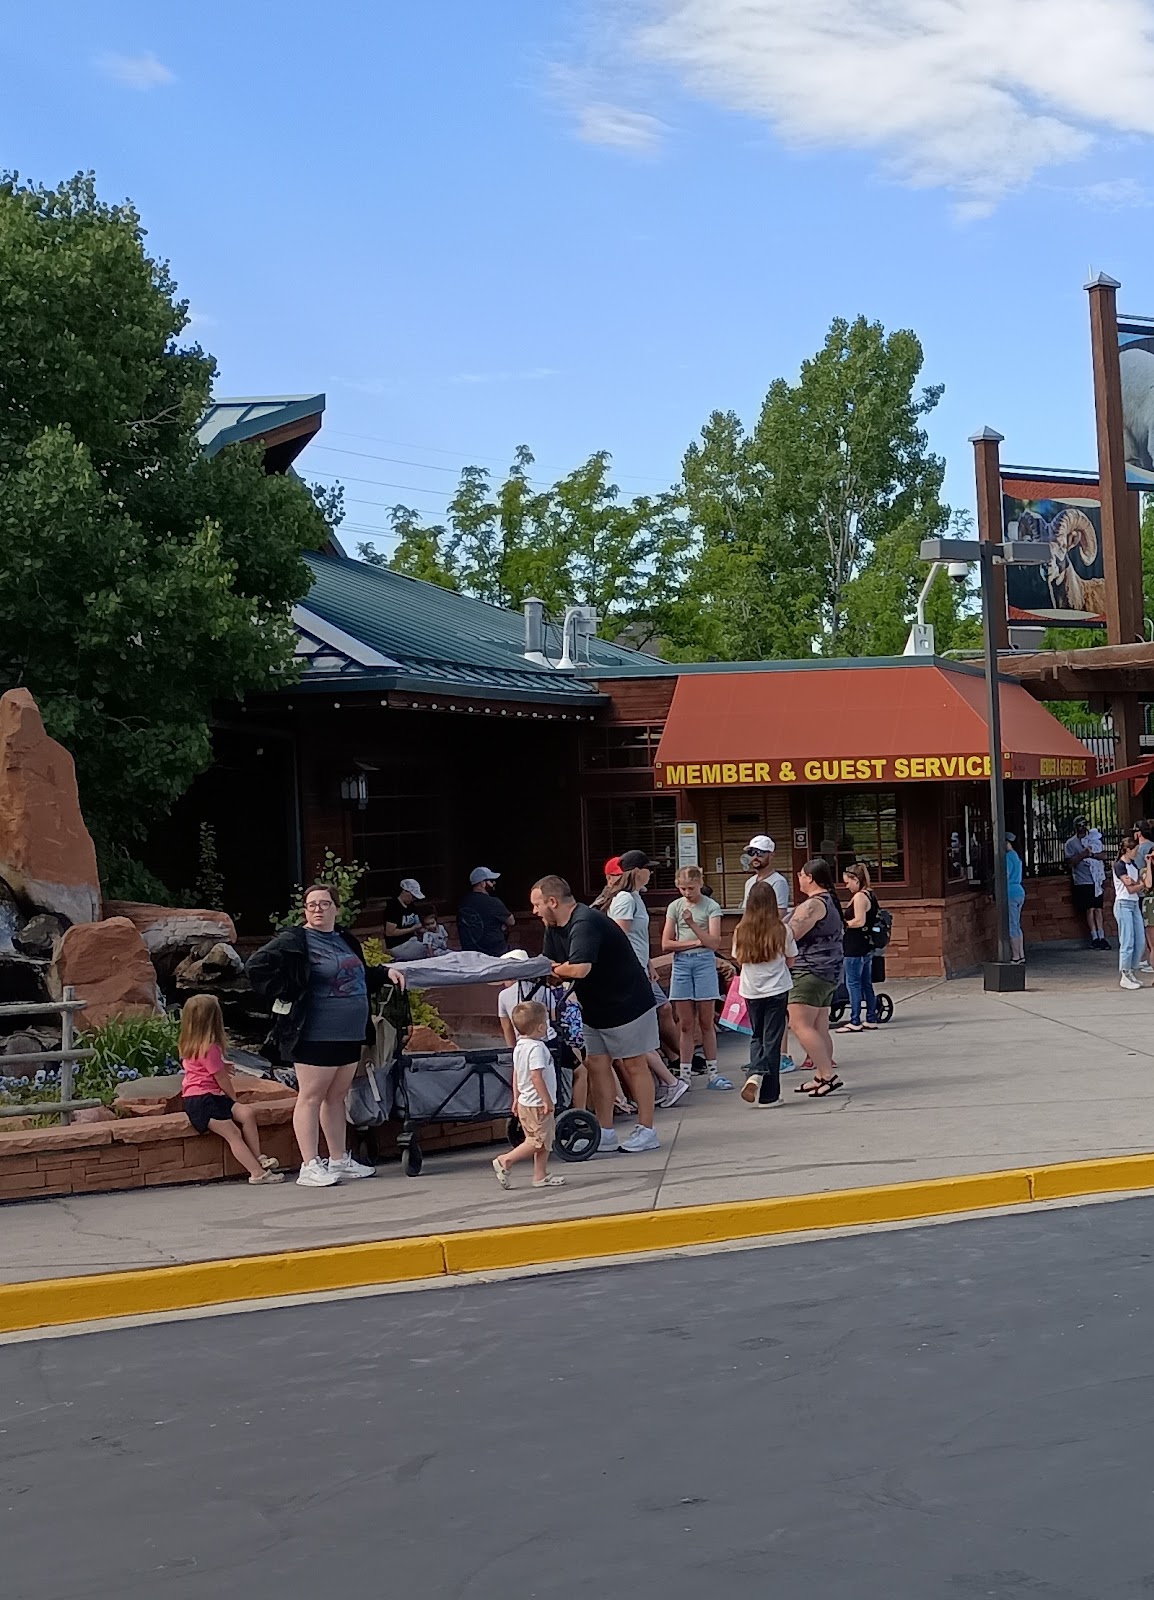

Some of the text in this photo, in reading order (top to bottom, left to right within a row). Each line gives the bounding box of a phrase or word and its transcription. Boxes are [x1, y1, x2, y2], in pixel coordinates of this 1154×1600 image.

[666, 762, 771, 785] MEMBER
[778, 761, 797, 782] &
[804, 759, 887, 781] GUEST
